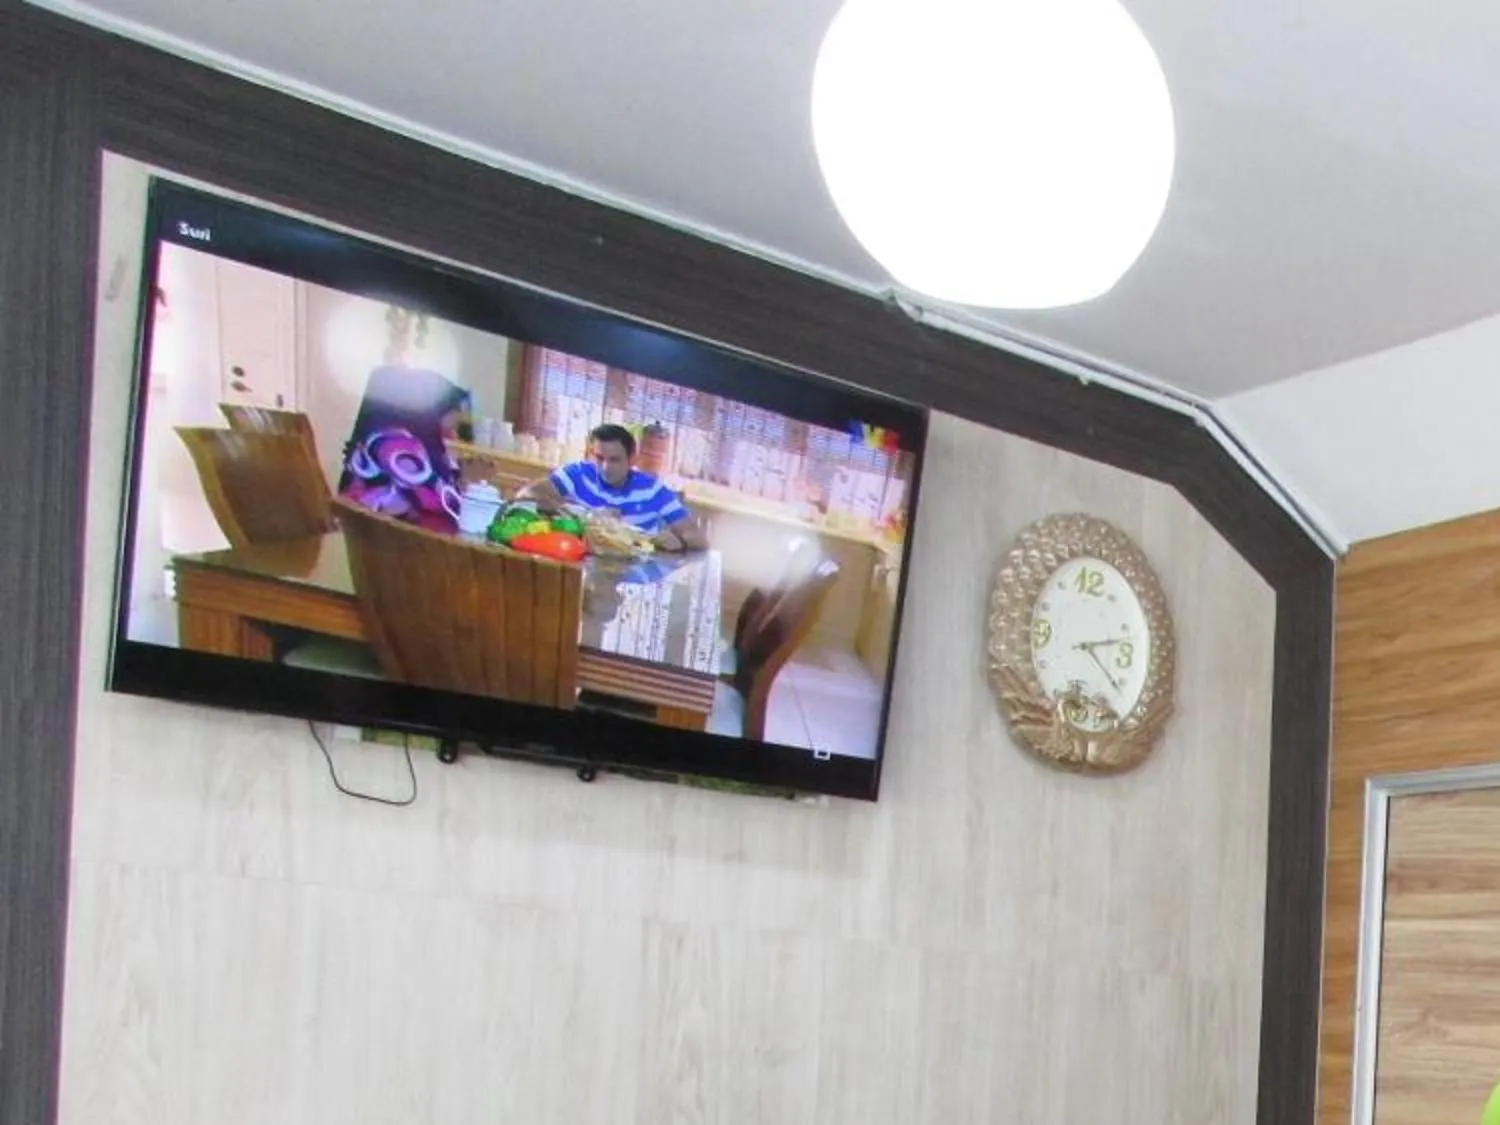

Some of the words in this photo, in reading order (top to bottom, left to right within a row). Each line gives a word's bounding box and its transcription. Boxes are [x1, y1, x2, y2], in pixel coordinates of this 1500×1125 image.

[1073, 567, 1104, 597] 12
[1033, 619, 1052, 648] 9
[1115, 641, 1134, 670] 3
